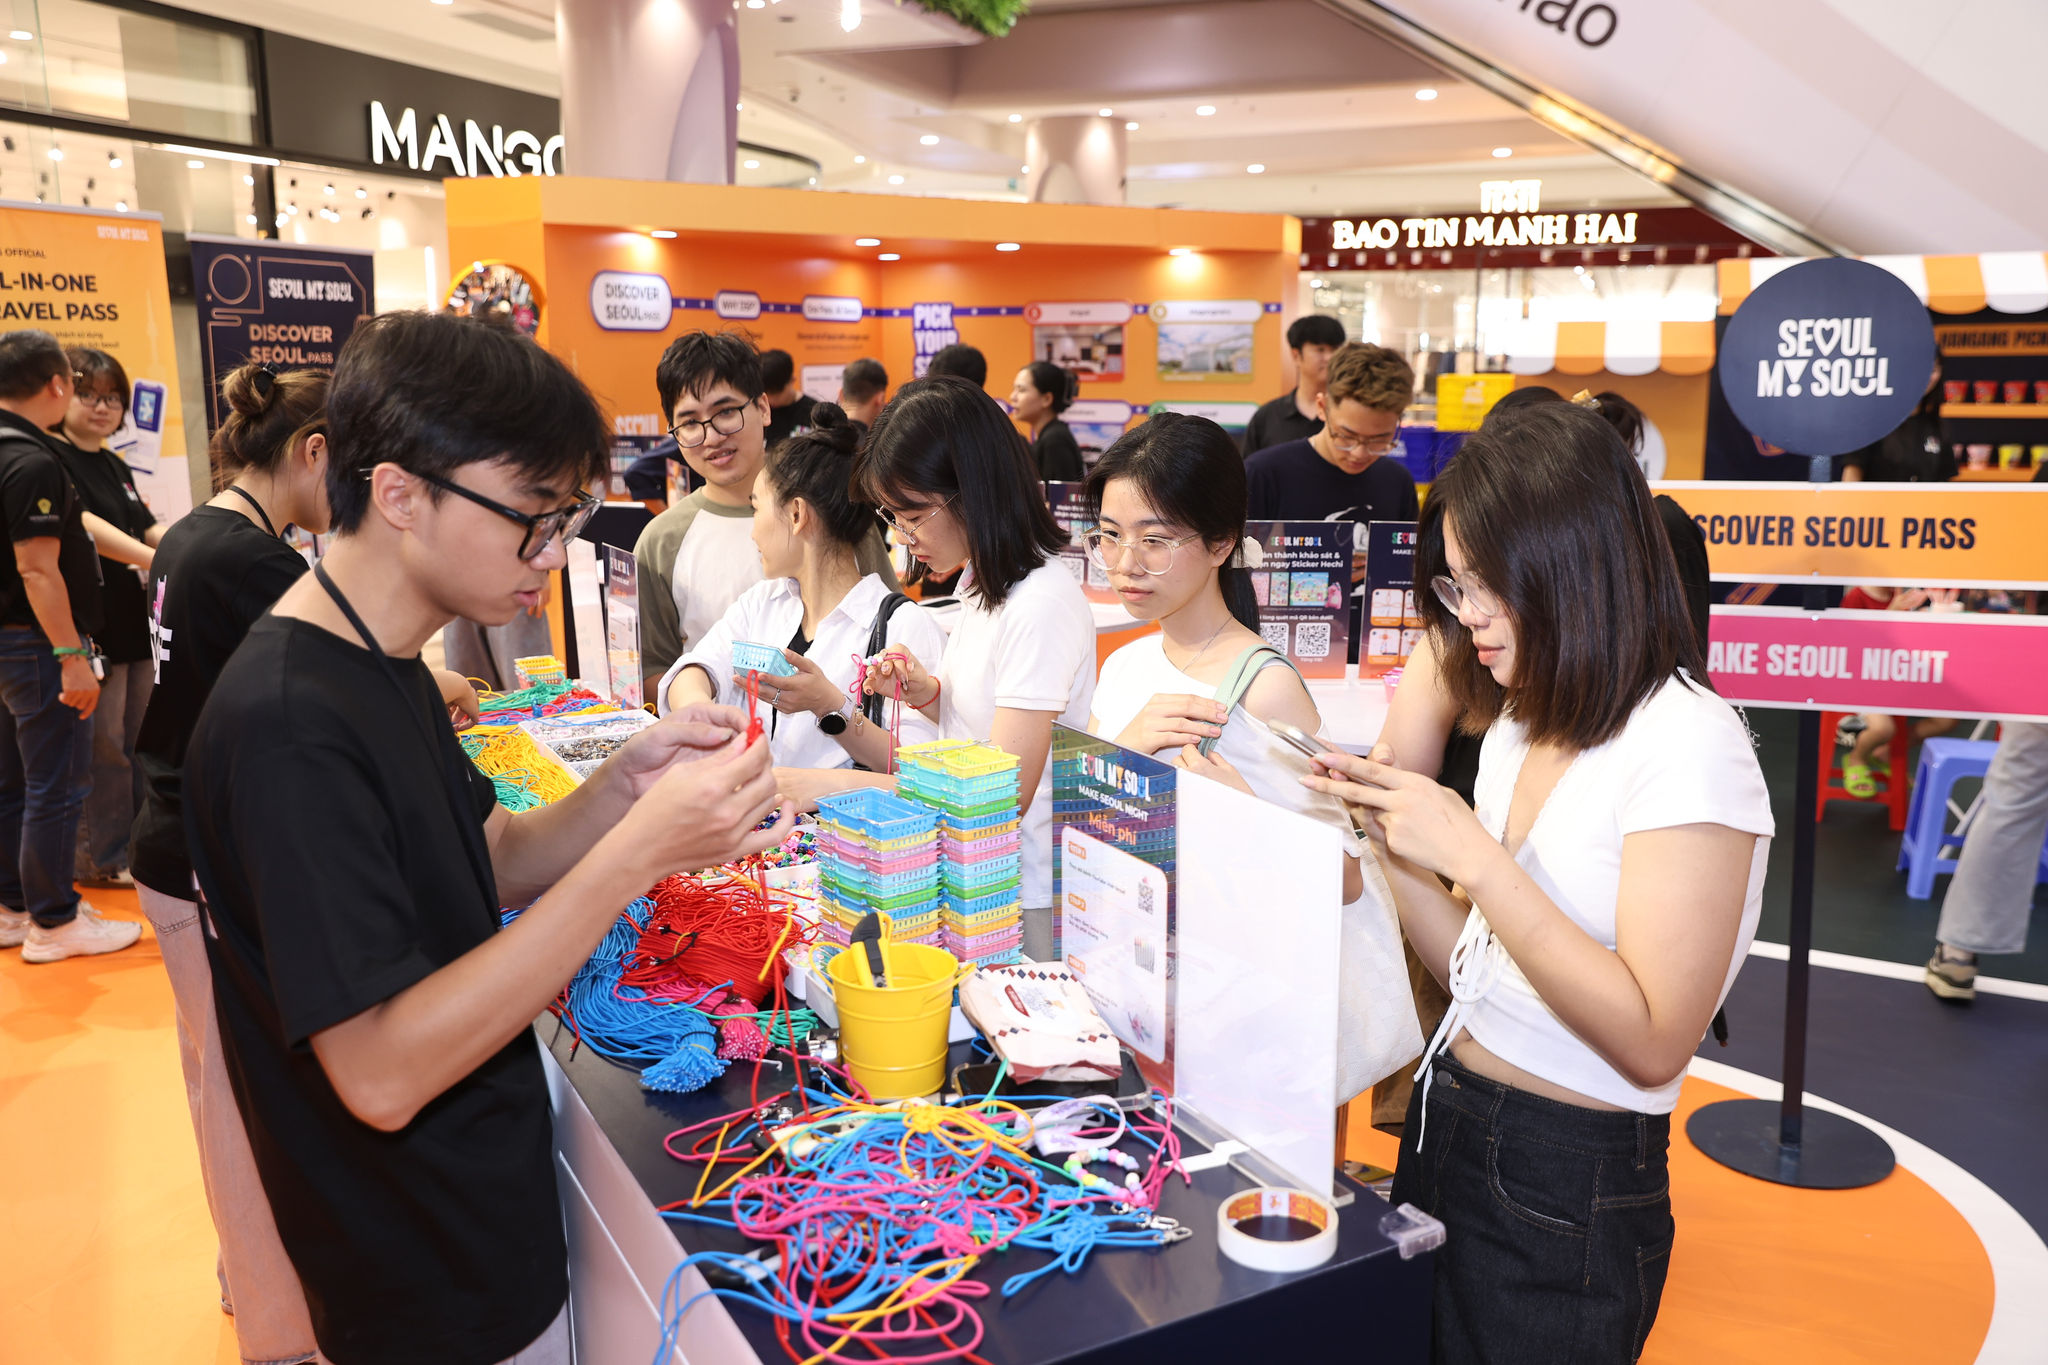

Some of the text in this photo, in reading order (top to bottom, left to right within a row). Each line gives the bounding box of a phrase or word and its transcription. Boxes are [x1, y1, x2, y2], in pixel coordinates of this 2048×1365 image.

[1518, 0, 1617, 47] ao
[1332, 212, 1638, 249] BAO TIN MANH HAI
[5, 248, 46, 258] OFFICIAL
[0, 272, 98, 292] L-IN-ONE
[268, 277, 354, 302] SEOUL MY SOUL
[605, 283, 660, 300] DISCOVER
[0, 301, 119, 321] AVEL PASS
[914, 304, 952, 329] PICK
[249, 323, 333, 343] DISCOVER
[1777, 317, 1877, 358] SEOUL
[250, 345, 334, 364] SEOUL PASS
[1810, 357, 1894, 397] SOUL
[1271, 536, 1292, 546] SEOUL
[1304, 536, 1322, 547] SOUL
[1689, 514, 1977, 550] SCOVER SEOUL PASS
[1291, 560, 1319, 568] Sticker
[1707, 640, 1949, 683] AKE SEOUL NIGHT
[1077, 751, 1106, 783] SEOUL
[1124, 769, 1151, 802] SOUL
[1078, 784, 1149, 822] MAKE SEOUL NIGHT
